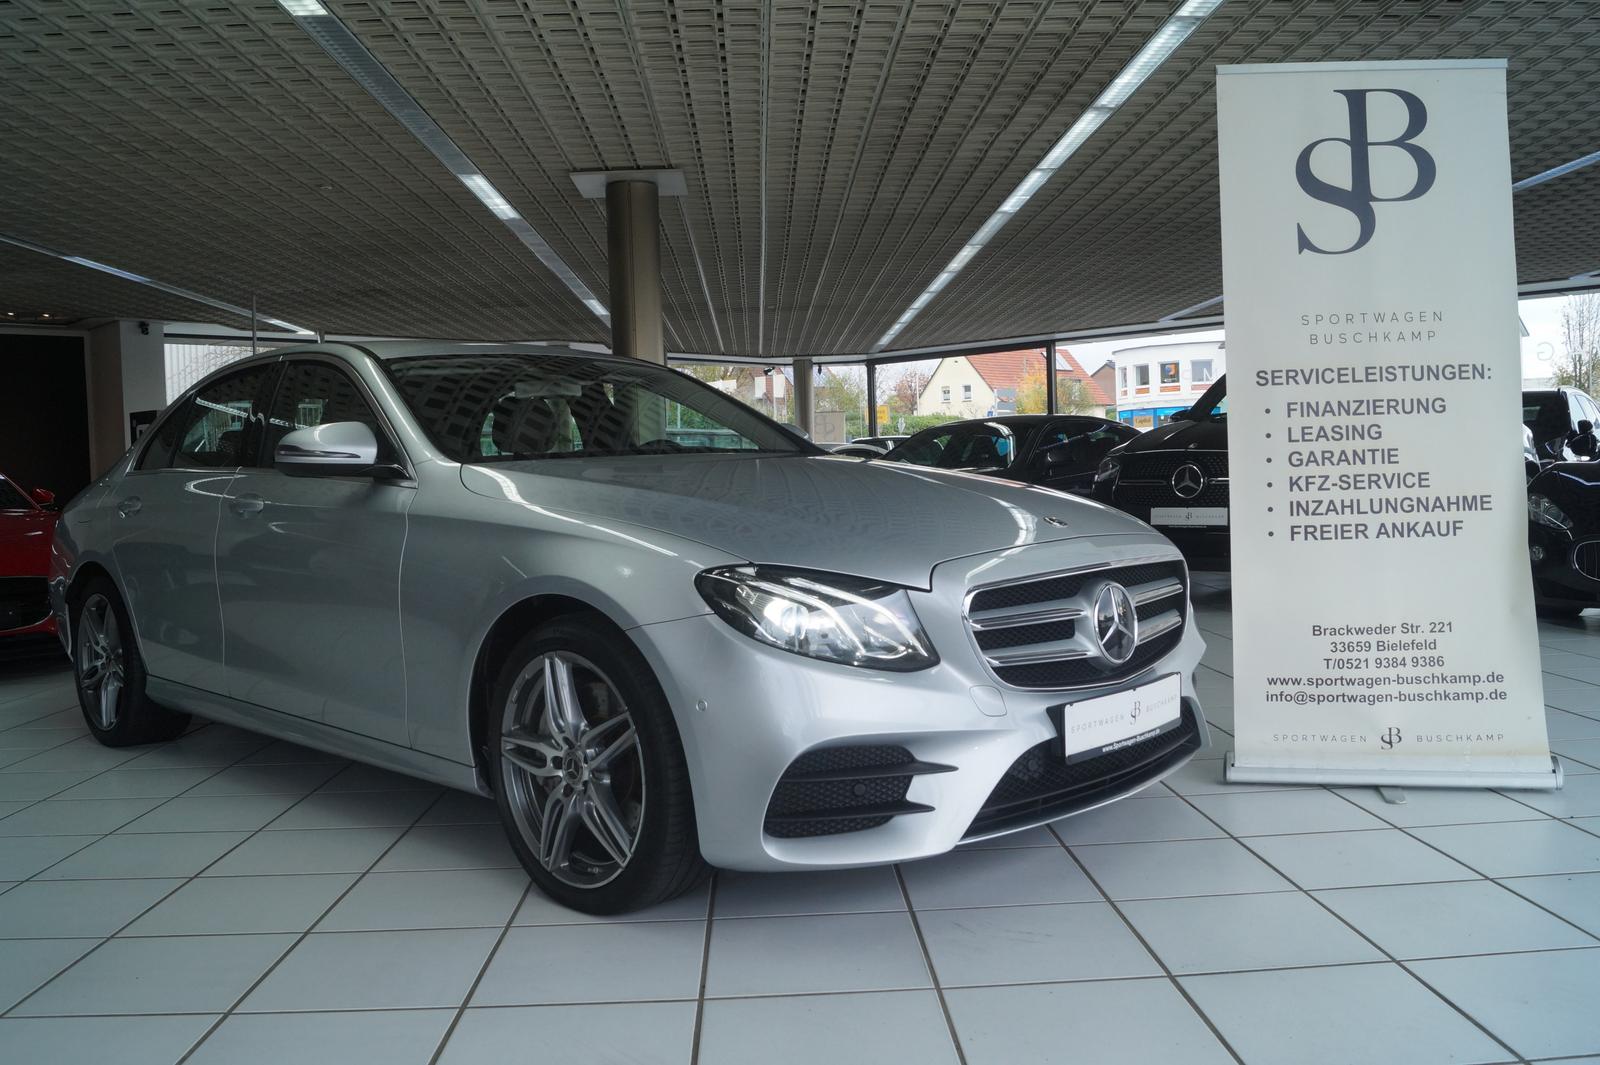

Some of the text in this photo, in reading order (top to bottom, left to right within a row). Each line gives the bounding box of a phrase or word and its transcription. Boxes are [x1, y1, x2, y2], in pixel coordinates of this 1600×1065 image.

[1300, 310, 1444, 327] SPORTWAGEN
[1309, 330, 1437, 345] BUSCHKAMP
[1255, 363, 1492, 387] SERVICELEISTUNGEN:
[1286, 397, 1448, 418] FINANZIERUNG
[1287, 423, 1383, 443] LEASING
[1287, 447, 1400, 468] GARANTIE
[1288, 471, 1431, 492] KFZ-SERVICE
[1289, 494, 1493, 517] INZAHLUNGNAHME
[1289, 520, 1464, 542] FREIER ANKAUF
[1311, 621, 1453, 637] Brackweder Str. 221
[1329, 638, 1437, 653] 33659 Bielefeld
[1322, 654, 1446, 670] T/0521 9384 9386
[1266, 671, 1505, 688] www.sportwagen-buschkamp.de
[1265, 688, 1508, 706] info@sportwagen-buschkamp.de
[1272, 733, 1369, 744] SPORTWAGEN
[1416, 733, 1505, 744] BUSCHKAMP
